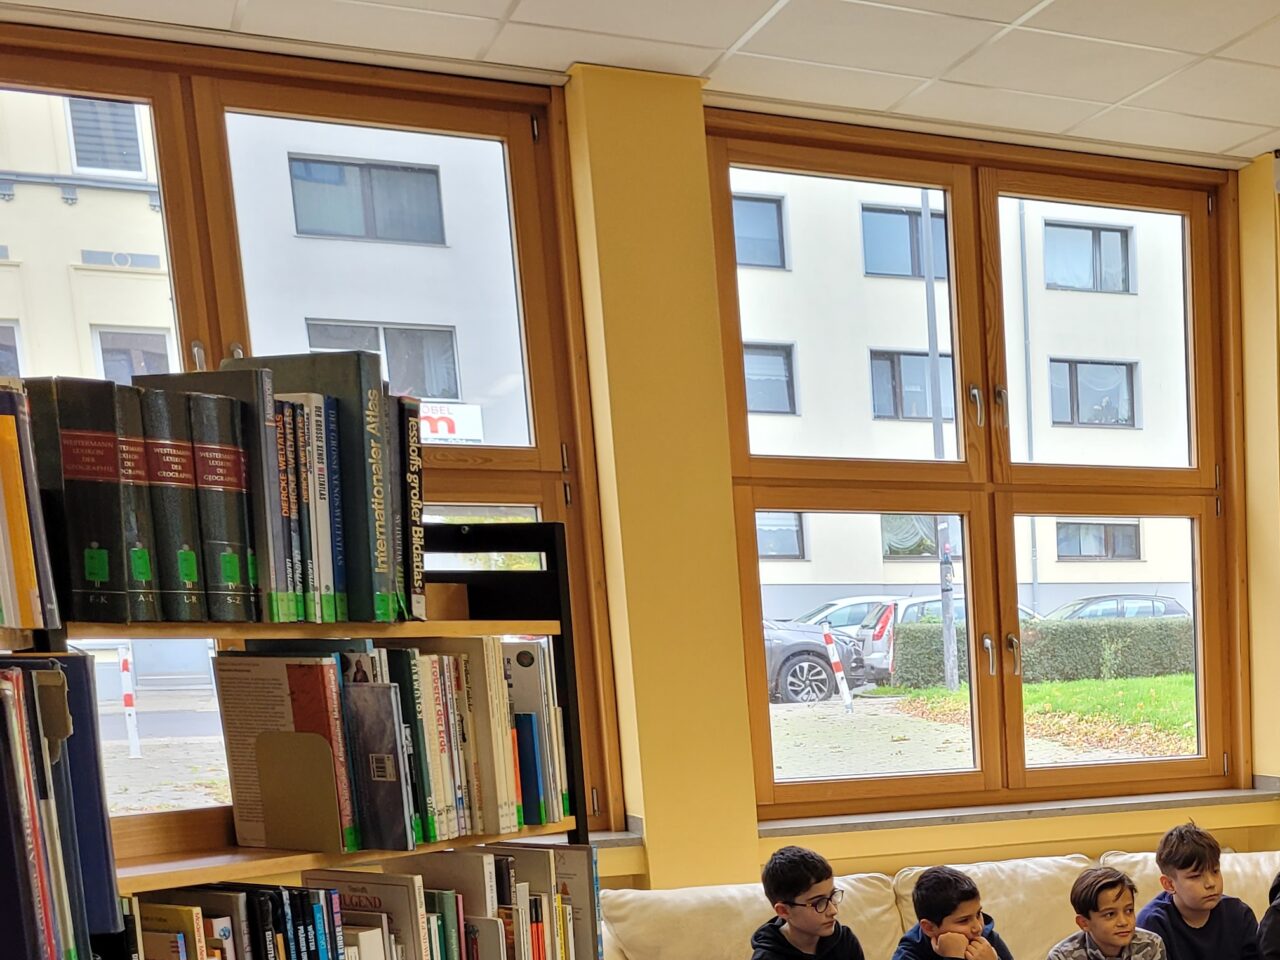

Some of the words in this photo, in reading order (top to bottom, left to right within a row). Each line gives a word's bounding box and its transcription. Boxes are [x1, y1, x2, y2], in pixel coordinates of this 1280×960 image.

[286, 407, 295, 467] WELTATLAS
[315, 419, 324, 443] GROSSE
[366, 388, 381, 437] Atlas
[277, 414, 286, 470] WELTATLAS
[408, 416, 422, 473] Tessloffs
[281, 473, 290, 517] DIERCKE
[317, 466, 327, 501] WELTATLAS
[368, 439, 388, 574] Internationaler
[411, 526, 425, 588] Bildatlas
[410, 658, 424, 720] KOLUMBUS
[343, 895, 382, 909] UGEND
